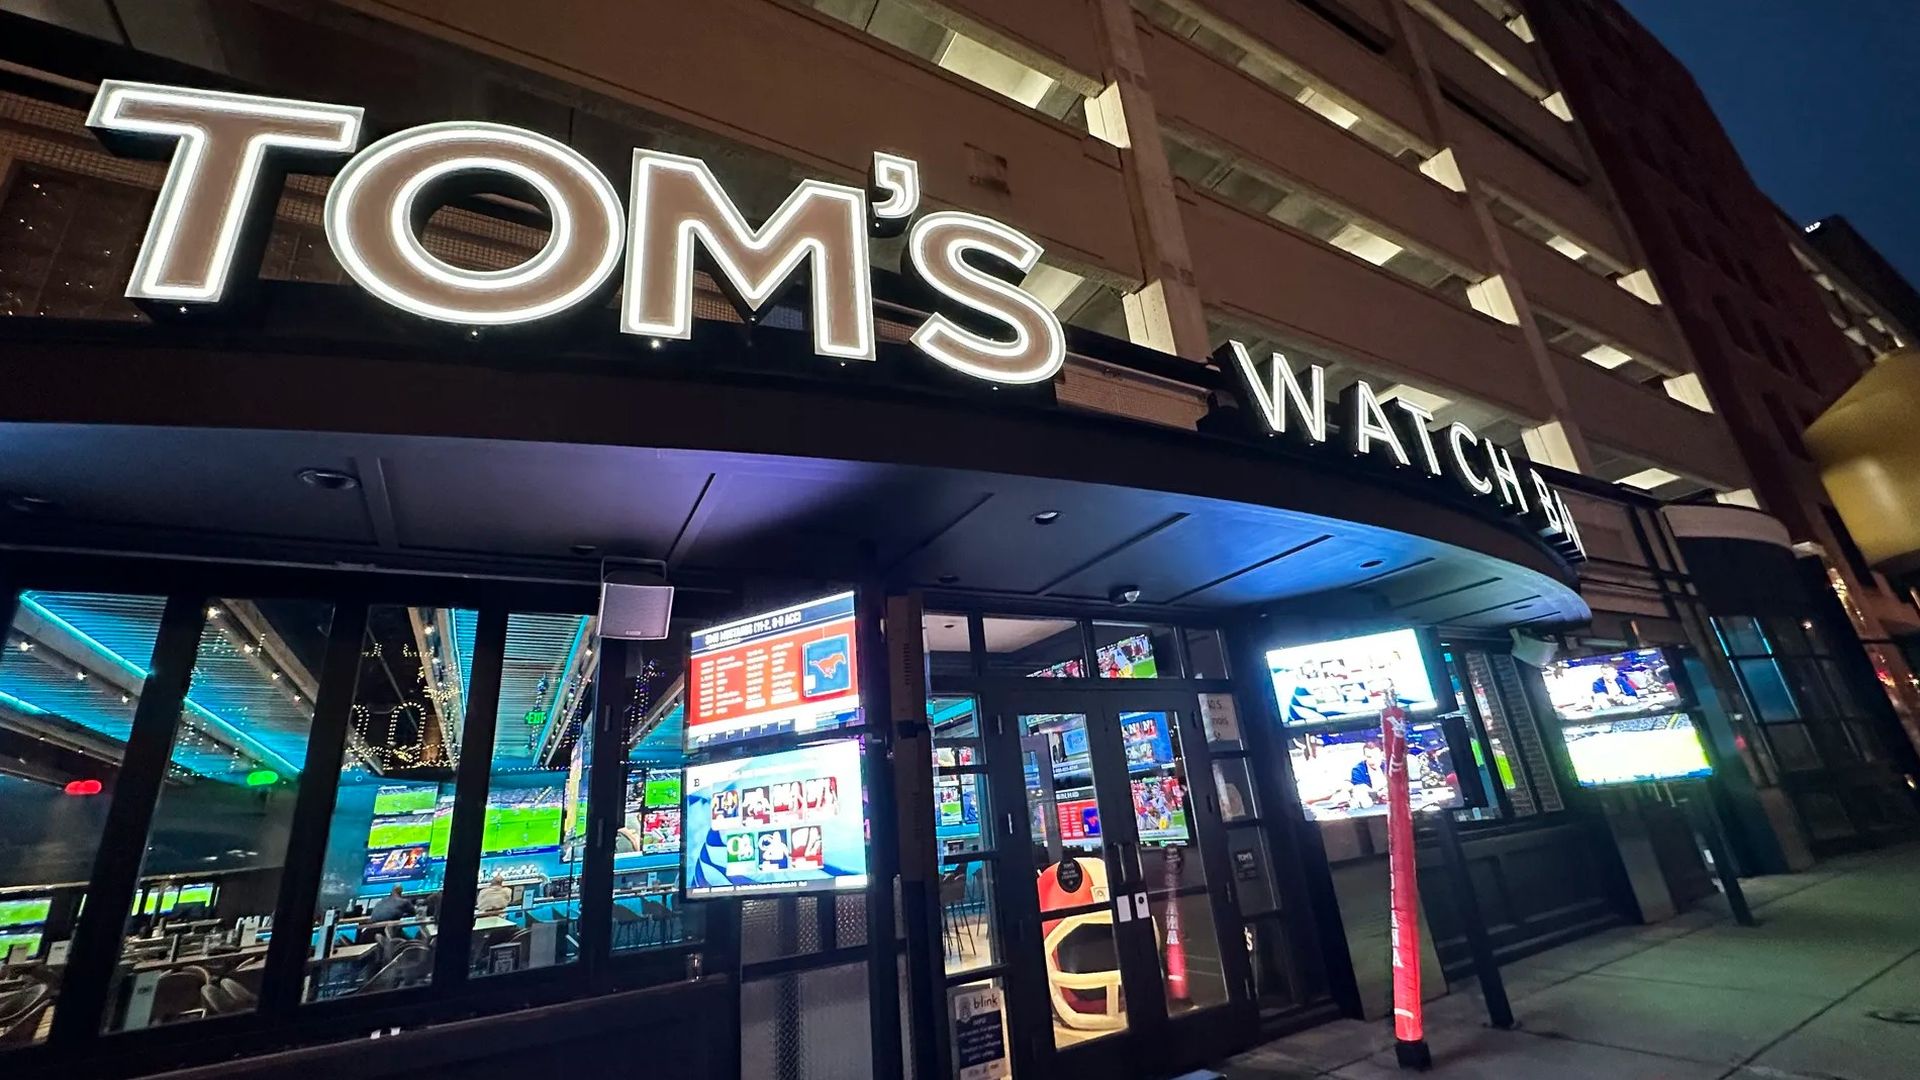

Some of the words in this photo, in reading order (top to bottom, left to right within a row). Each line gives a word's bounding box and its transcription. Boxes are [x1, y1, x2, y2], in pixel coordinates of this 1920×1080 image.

[85, 79, 1067, 386] TOM'S
[1229, 339, 1529, 515] WATCH
[974, 994, 998, 1009] blink
